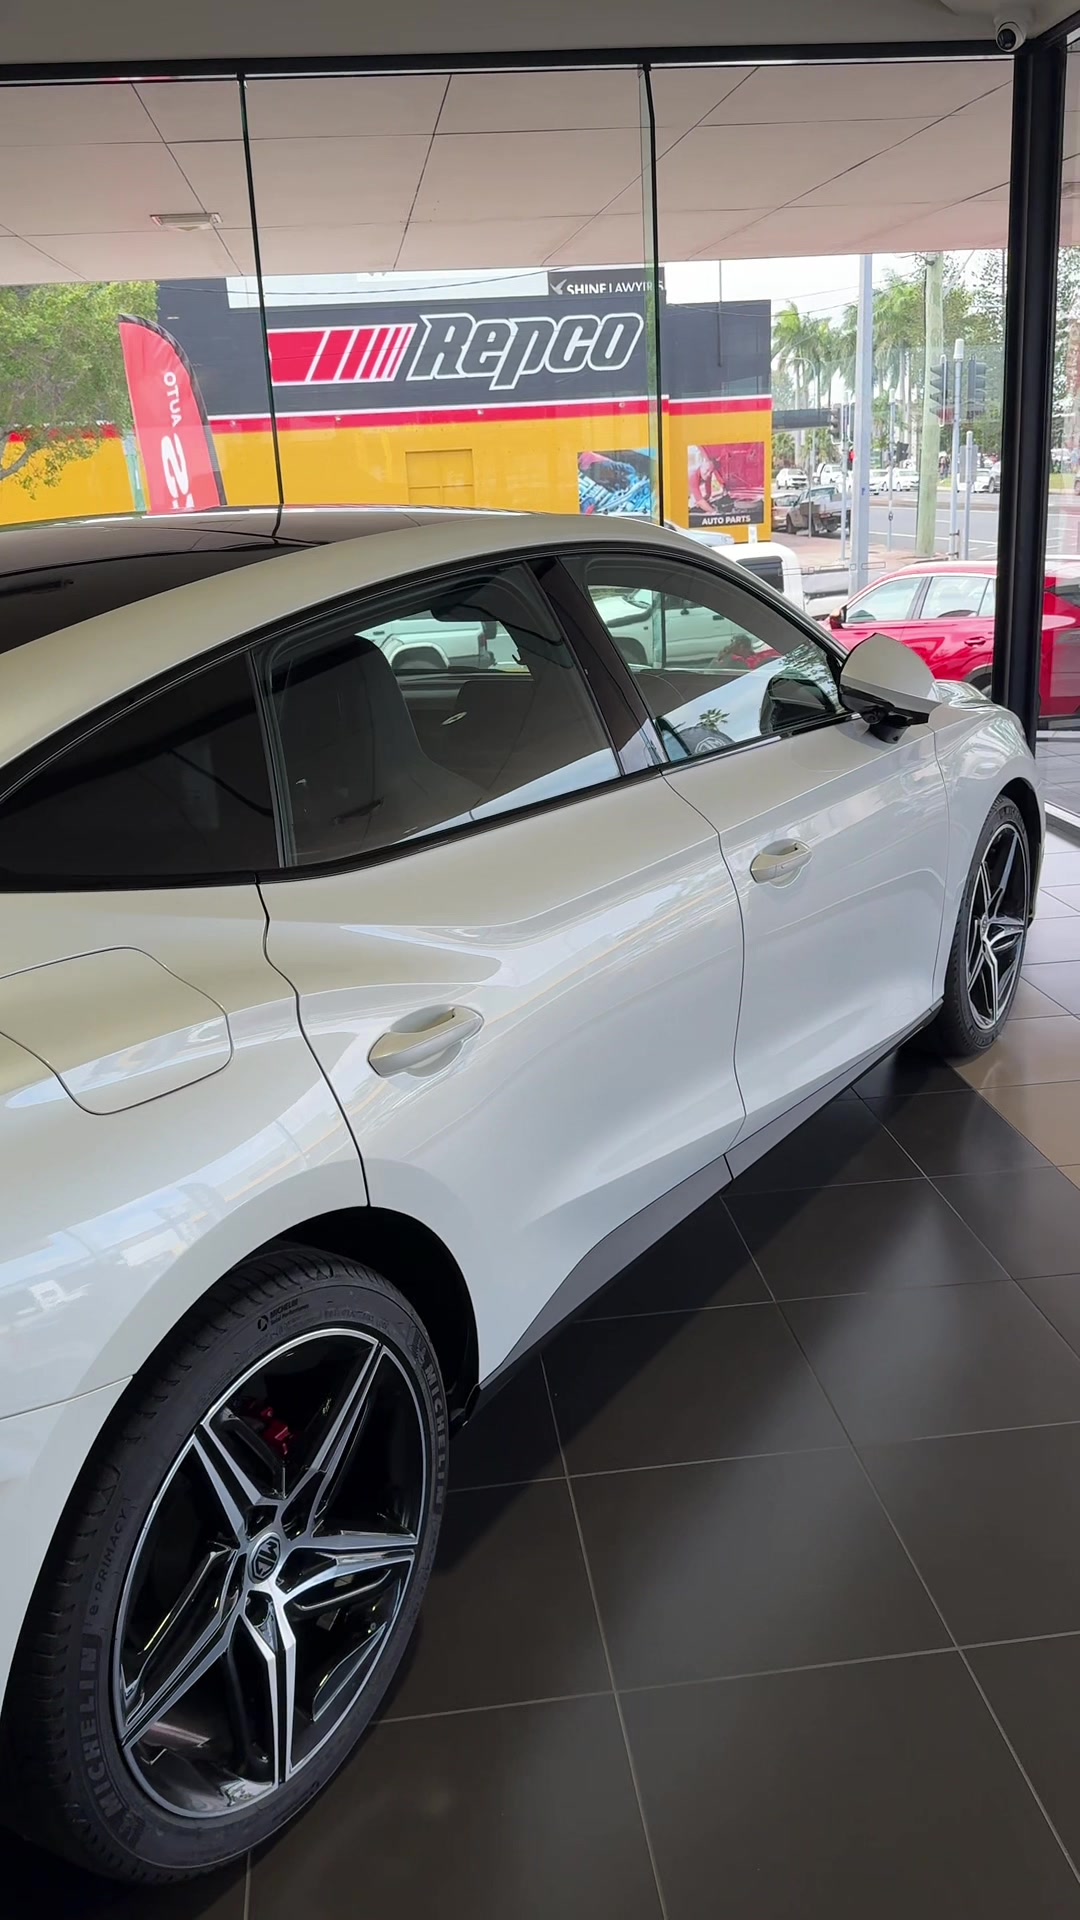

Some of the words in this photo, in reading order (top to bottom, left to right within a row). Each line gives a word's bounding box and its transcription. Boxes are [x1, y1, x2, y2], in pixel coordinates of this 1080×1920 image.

[406, 312, 645, 391] Repco
[702, 516, 724, 526] AUTO
[725, 515, 751, 524] PARTS
[424, 1363, 446, 1504] MICHELIN
[79, 1647, 123, 1819] MICHELIN
